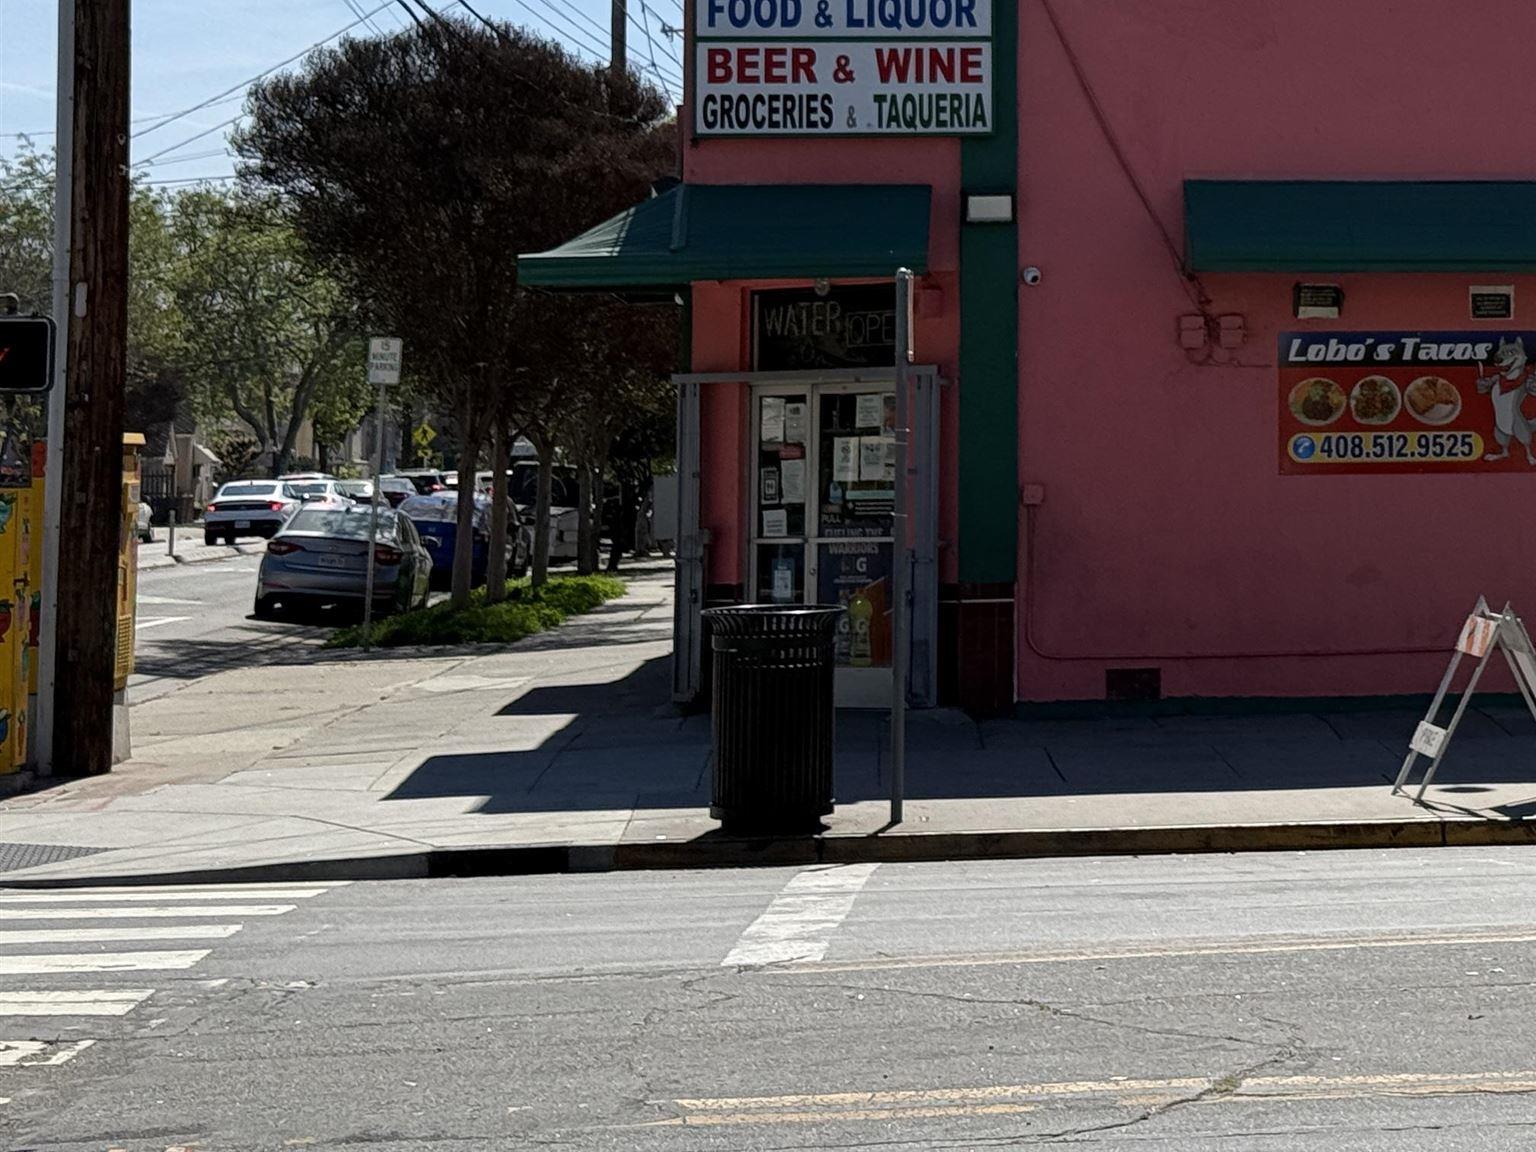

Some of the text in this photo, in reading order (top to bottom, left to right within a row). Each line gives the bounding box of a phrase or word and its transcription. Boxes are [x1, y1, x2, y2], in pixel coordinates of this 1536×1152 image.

[814, 0, 833, 28] &
[707, 47, 984, 84] BEER & WINE
[703, 93, 987, 131] GROCERIES & TAQUERIA
[764, 301, 842, 337] WATER
[850, 314, 896, 345] OPE
[372, 352, 398, 362] MINUTE
[1288, 337, 1492, 362] Lobo's Tacos
[369, 362, 399, 372] PARKING
[1320, 434, 1474, 459] 408.512.9525
